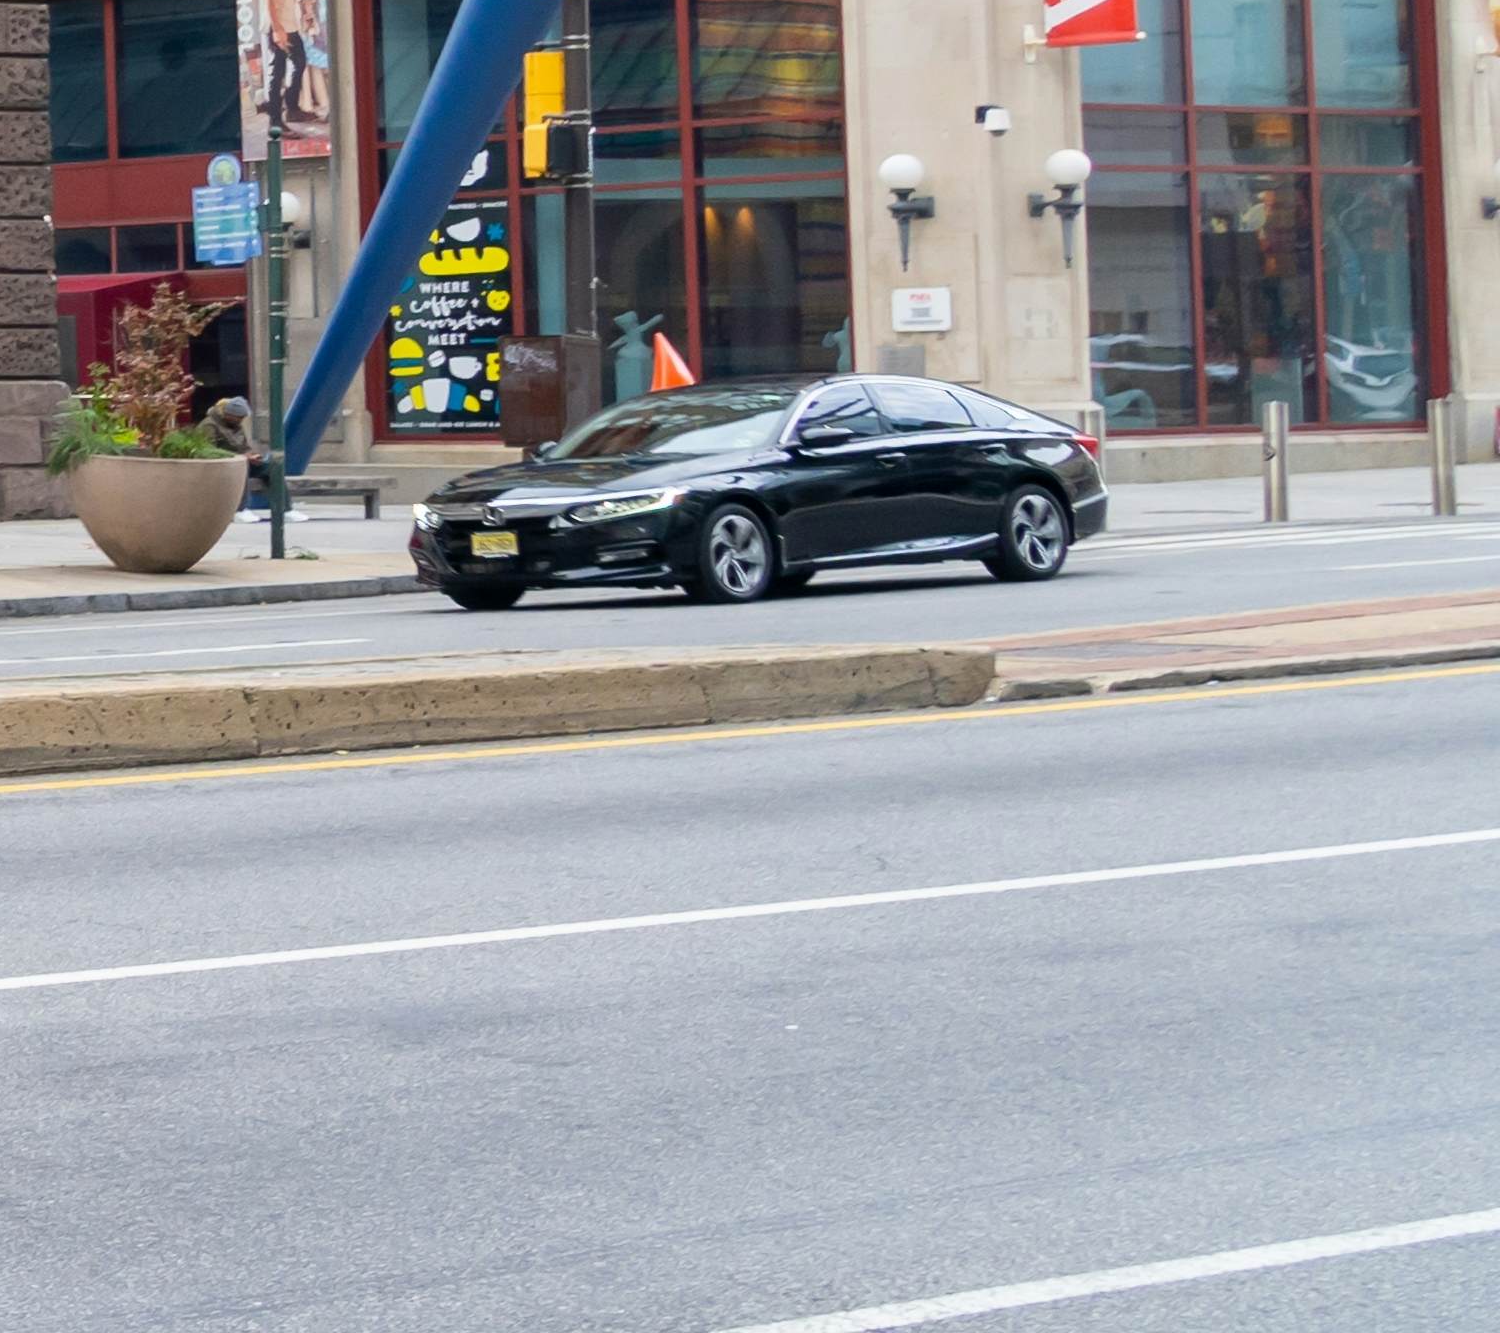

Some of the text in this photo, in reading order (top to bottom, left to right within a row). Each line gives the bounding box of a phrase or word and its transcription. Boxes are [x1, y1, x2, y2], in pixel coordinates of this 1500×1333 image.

[419, 281, 470, 293] WHERE
[409, 295, 468, 317] coffee
[428, 333, 467, 345] MEET
